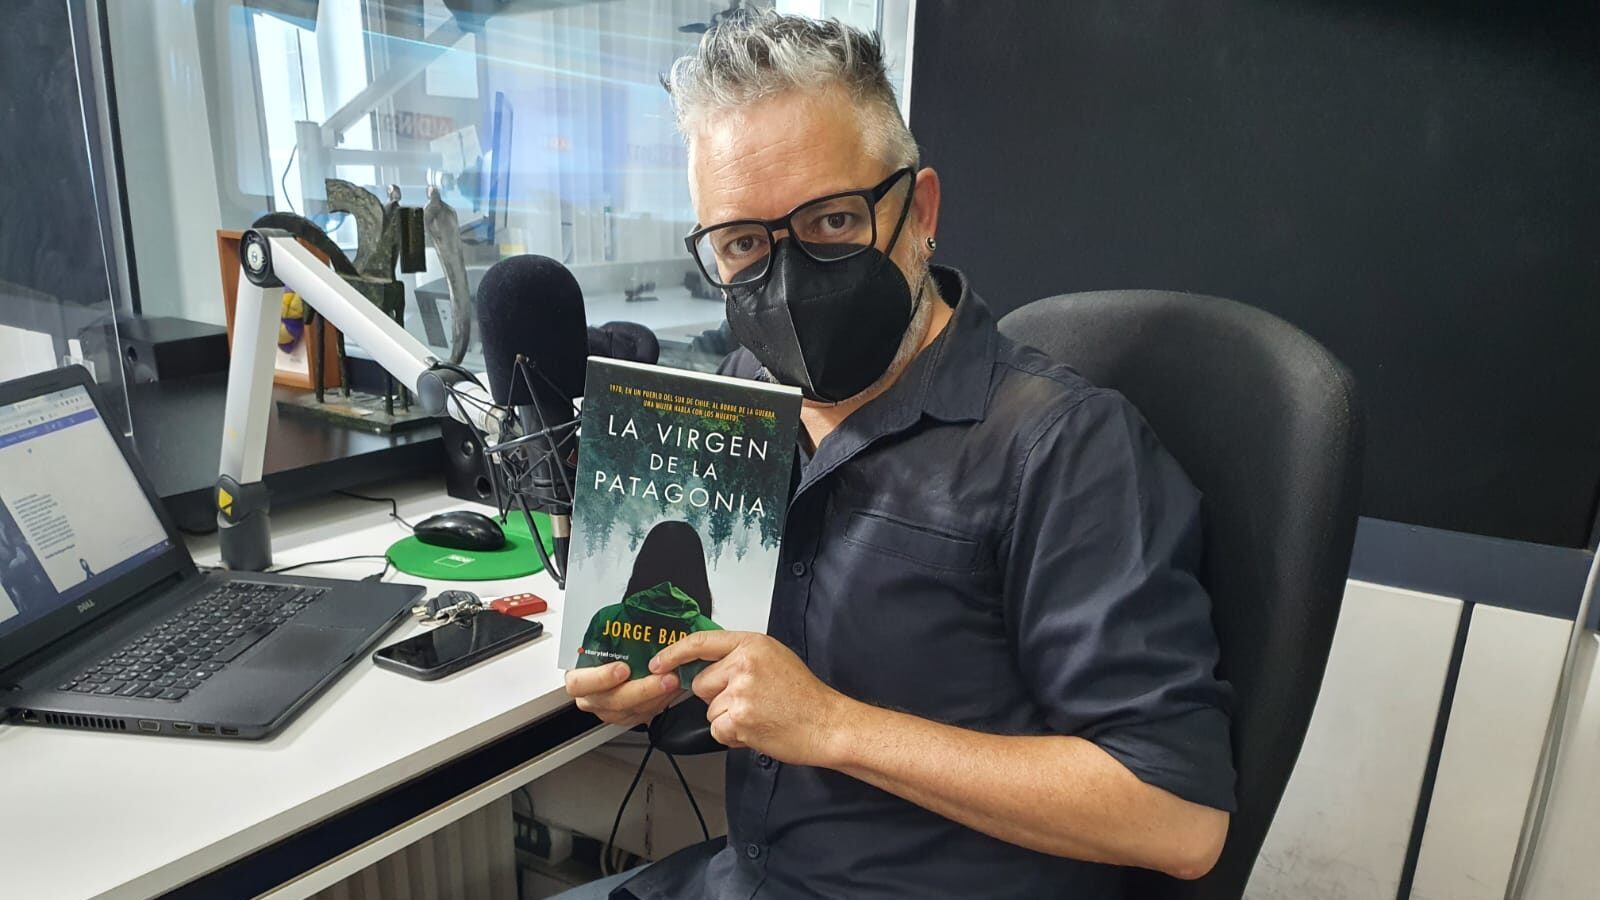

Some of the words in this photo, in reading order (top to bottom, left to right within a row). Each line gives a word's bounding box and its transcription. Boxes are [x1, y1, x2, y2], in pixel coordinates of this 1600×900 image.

[625, 387, 632, 395] EN
[643, 390, 662, 400] PUEBLO
[664, 393, 673, 402] DEL
[675, 395, 685, 403] SUR
[687, 397, 694, 405] DE
[712, 402, 718, 410] AL
[720, 403, 737, 412] BORDE
[738, 406, 745, 414] DE
[656, 402, 672, 411] MUJER
[674, 405, 690, 414] HABLA
[692, 408, 703, 416] CON
[608, 414, 639, 440] LA
[657, 423, 768, 461] VIRGEN
[650, 454, 678, 474] DE
[692, 460, 717, 481] LA
[594, 470, 765, 517] PATAGONIA
[602, 620, 652, 642] JORGE
